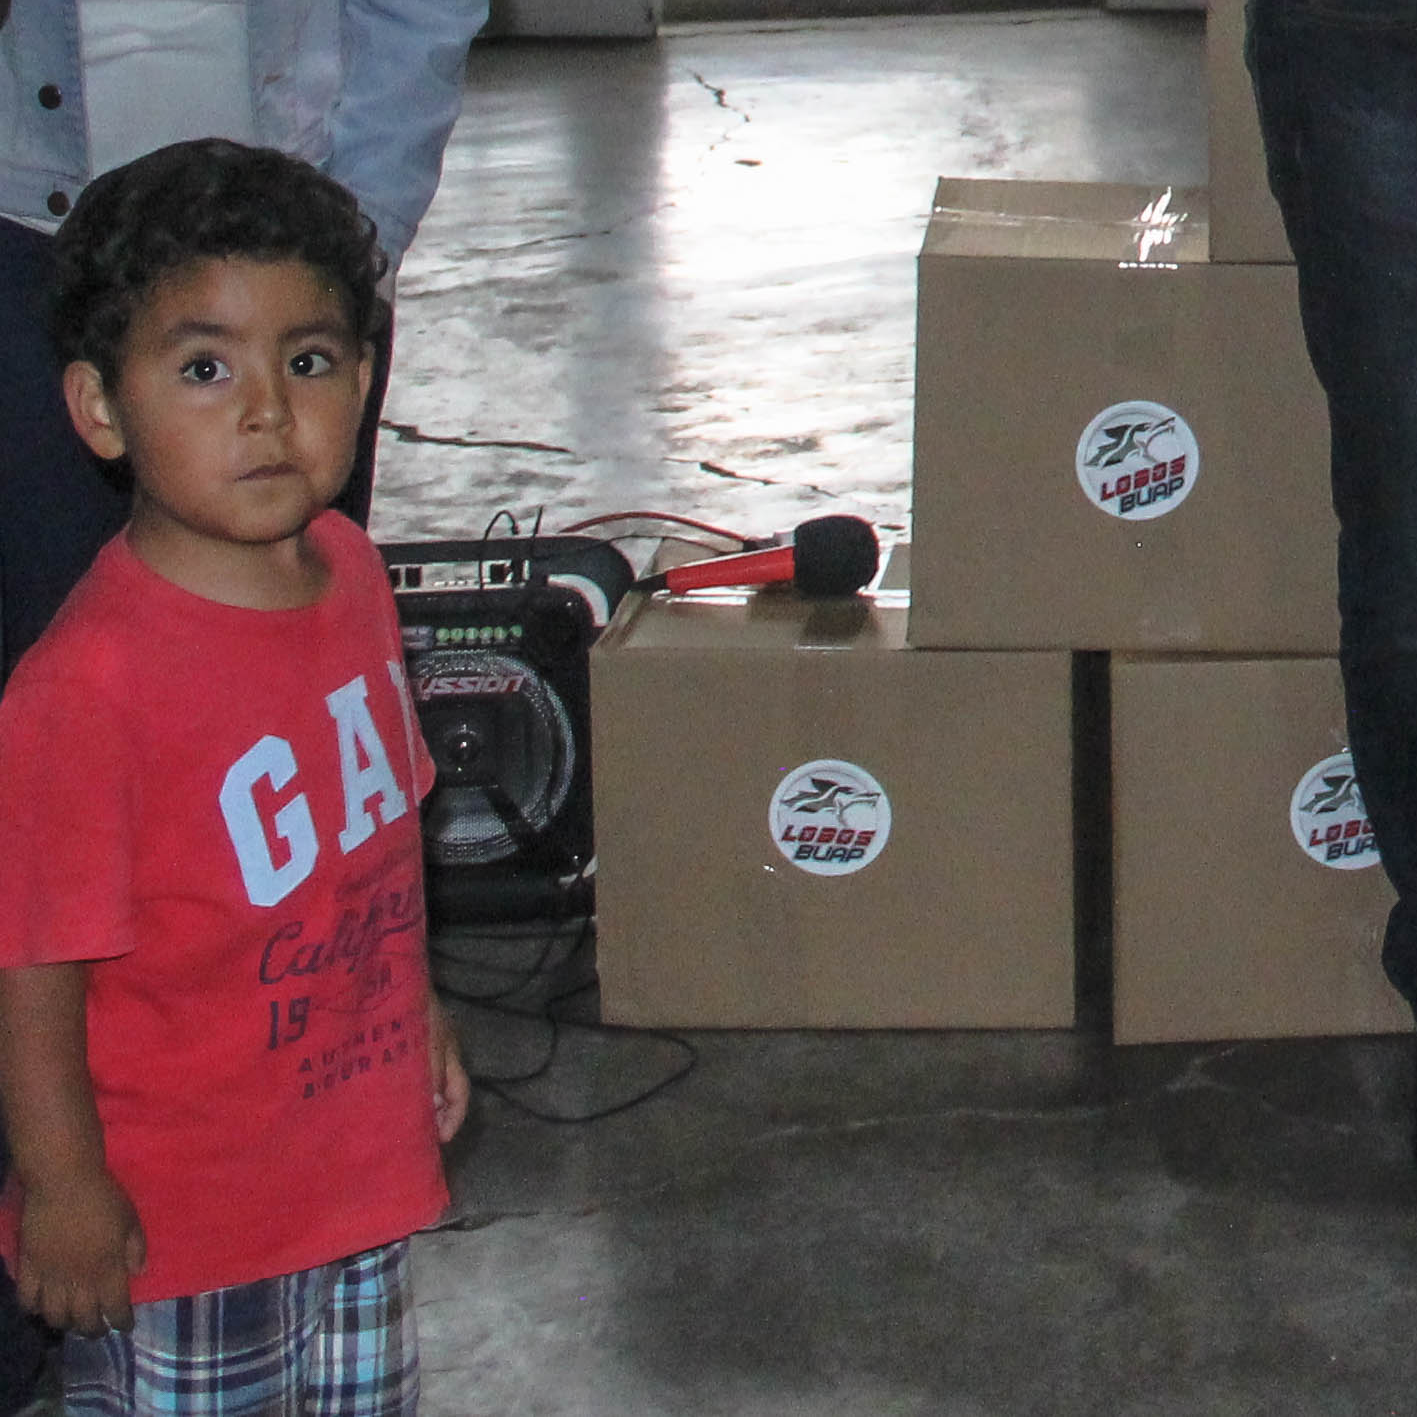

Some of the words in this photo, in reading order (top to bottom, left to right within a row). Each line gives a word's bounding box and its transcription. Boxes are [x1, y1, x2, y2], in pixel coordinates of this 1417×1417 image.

[1101, 454, 1186, 501] LOBOS
[1119, 477, 1185, 514] BUAP
[781, 825, 876, 846] LOBOS
[1326, 835, 1378, 861] BUA
[794, 844, 865, 862] BUAP
